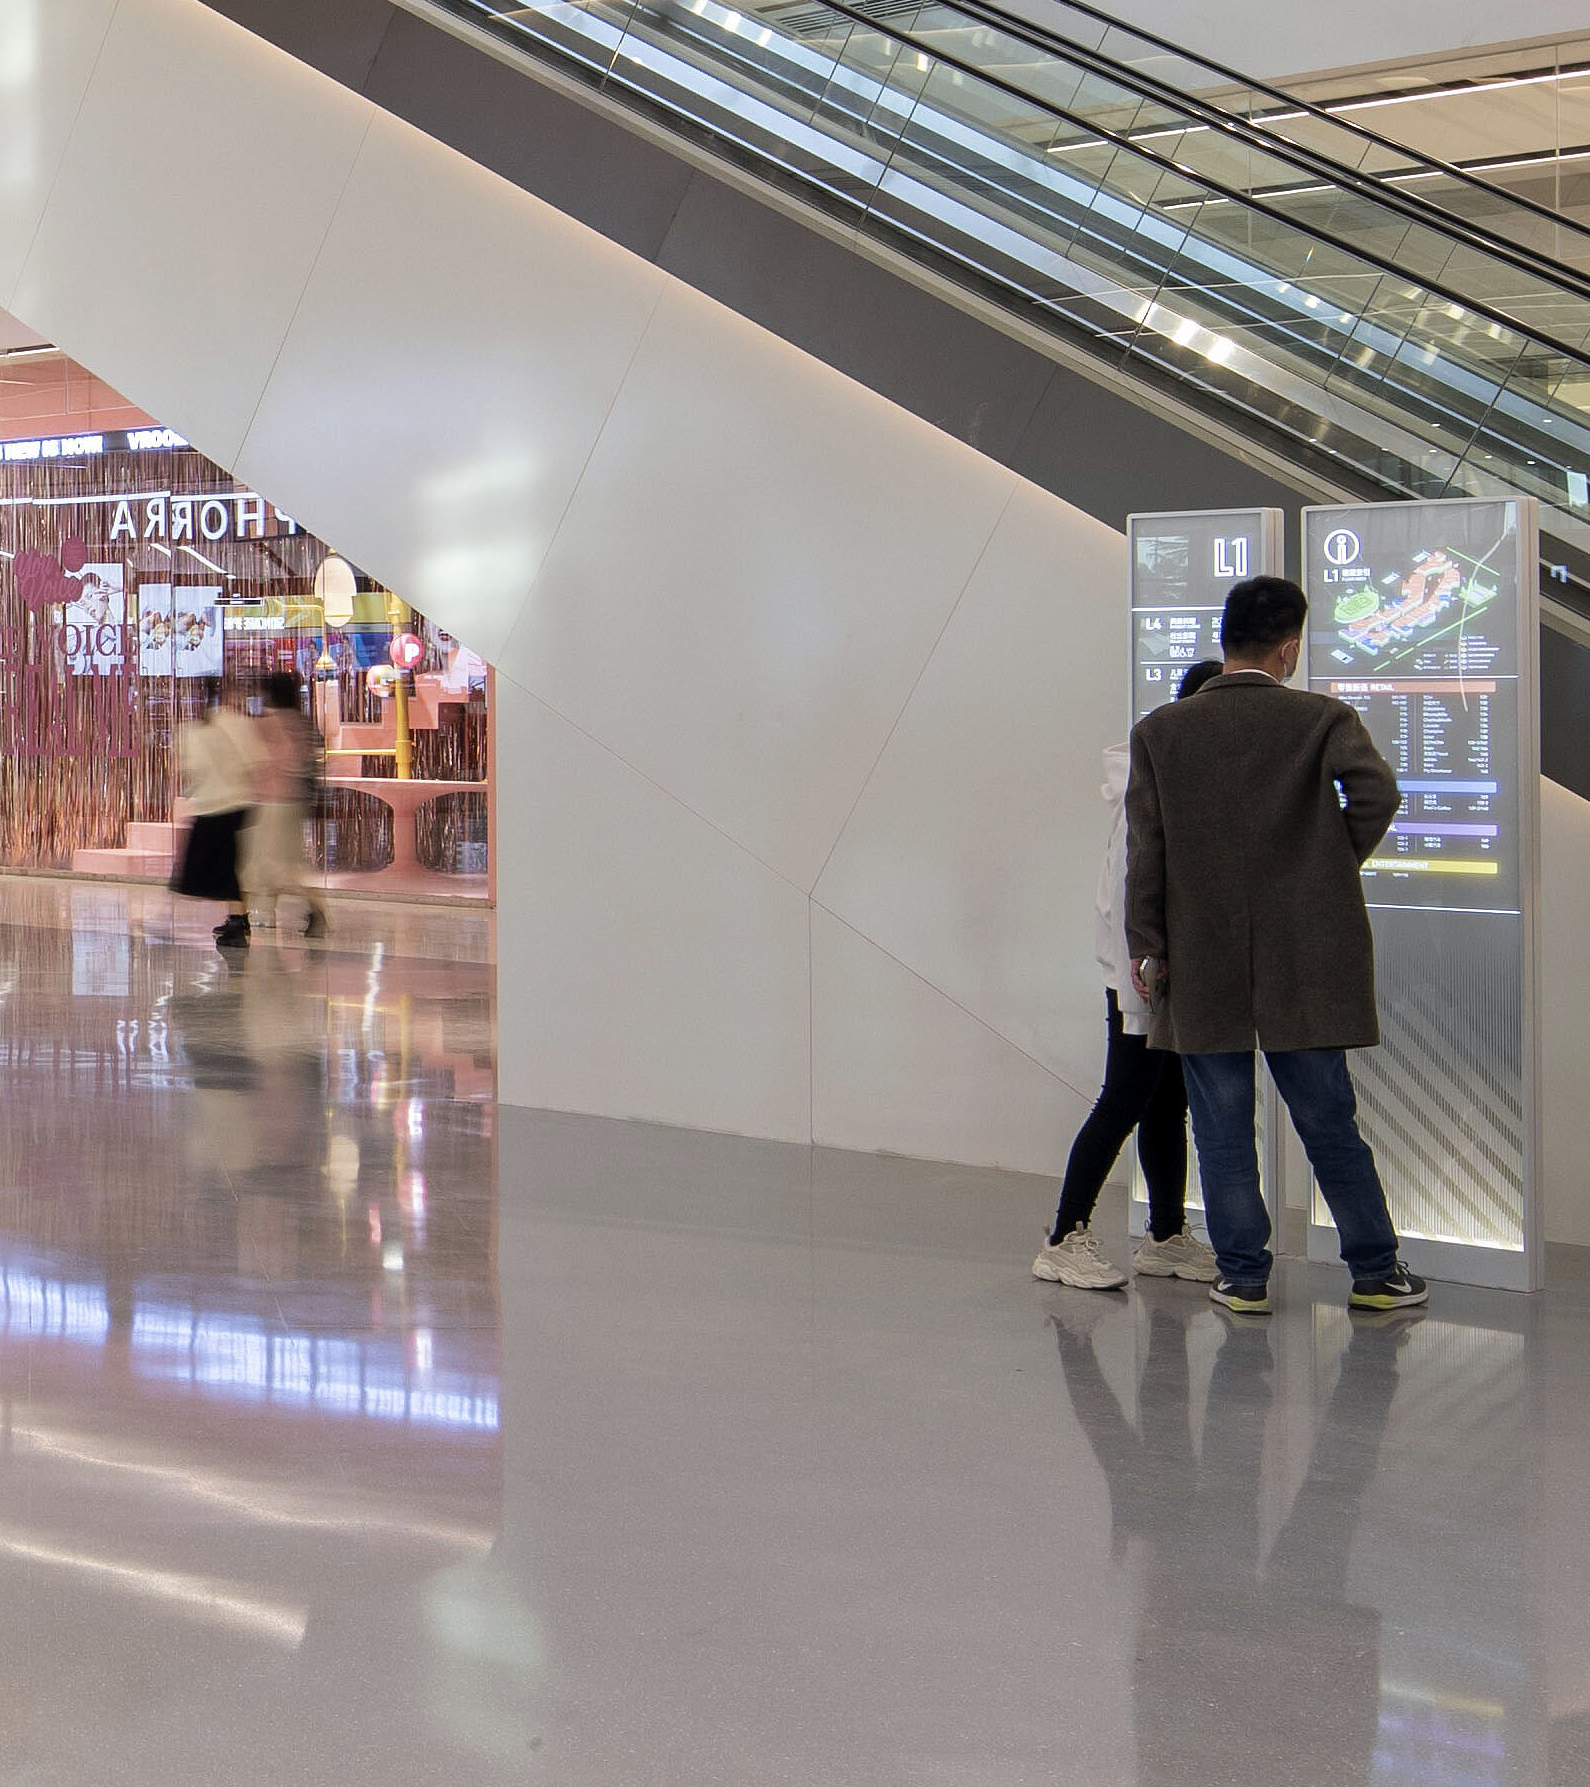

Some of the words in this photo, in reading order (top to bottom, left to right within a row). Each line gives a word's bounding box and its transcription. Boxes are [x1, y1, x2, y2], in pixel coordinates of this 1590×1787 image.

[1214, 537, 1248, 577] L1
[1323, 569, 1340, 583] L1
[1145, 617, 1162, 631] L4
[31, 623, 139, 658] VOICE
[1145, 668, 1162, 682] L3
